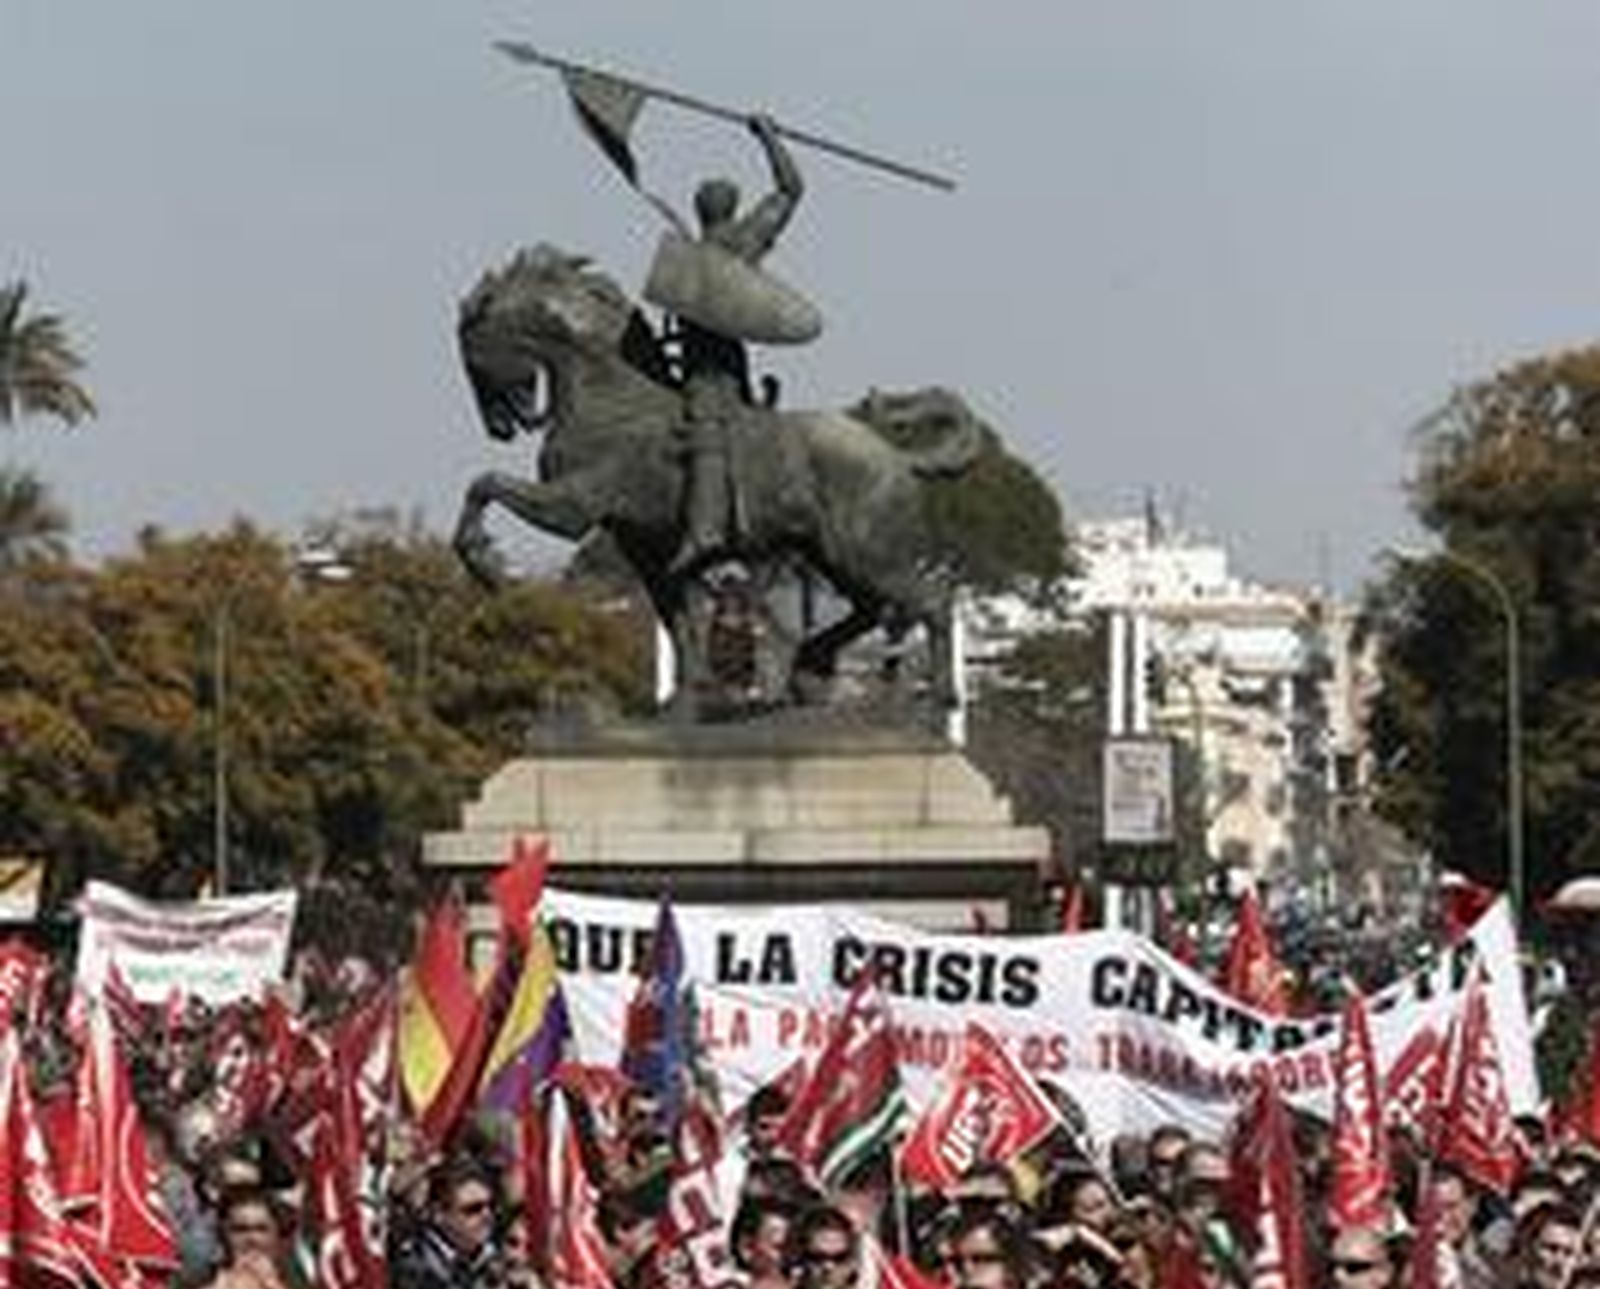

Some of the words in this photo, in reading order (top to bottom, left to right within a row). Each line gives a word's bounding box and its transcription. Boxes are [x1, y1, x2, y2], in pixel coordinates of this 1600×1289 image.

[547, 917, 655, 975] QUE
[716, 933, 798, 985] LA
[831, 935, 1041, 1008] CRISIS
[703, 1007, 750, 1048] LA
